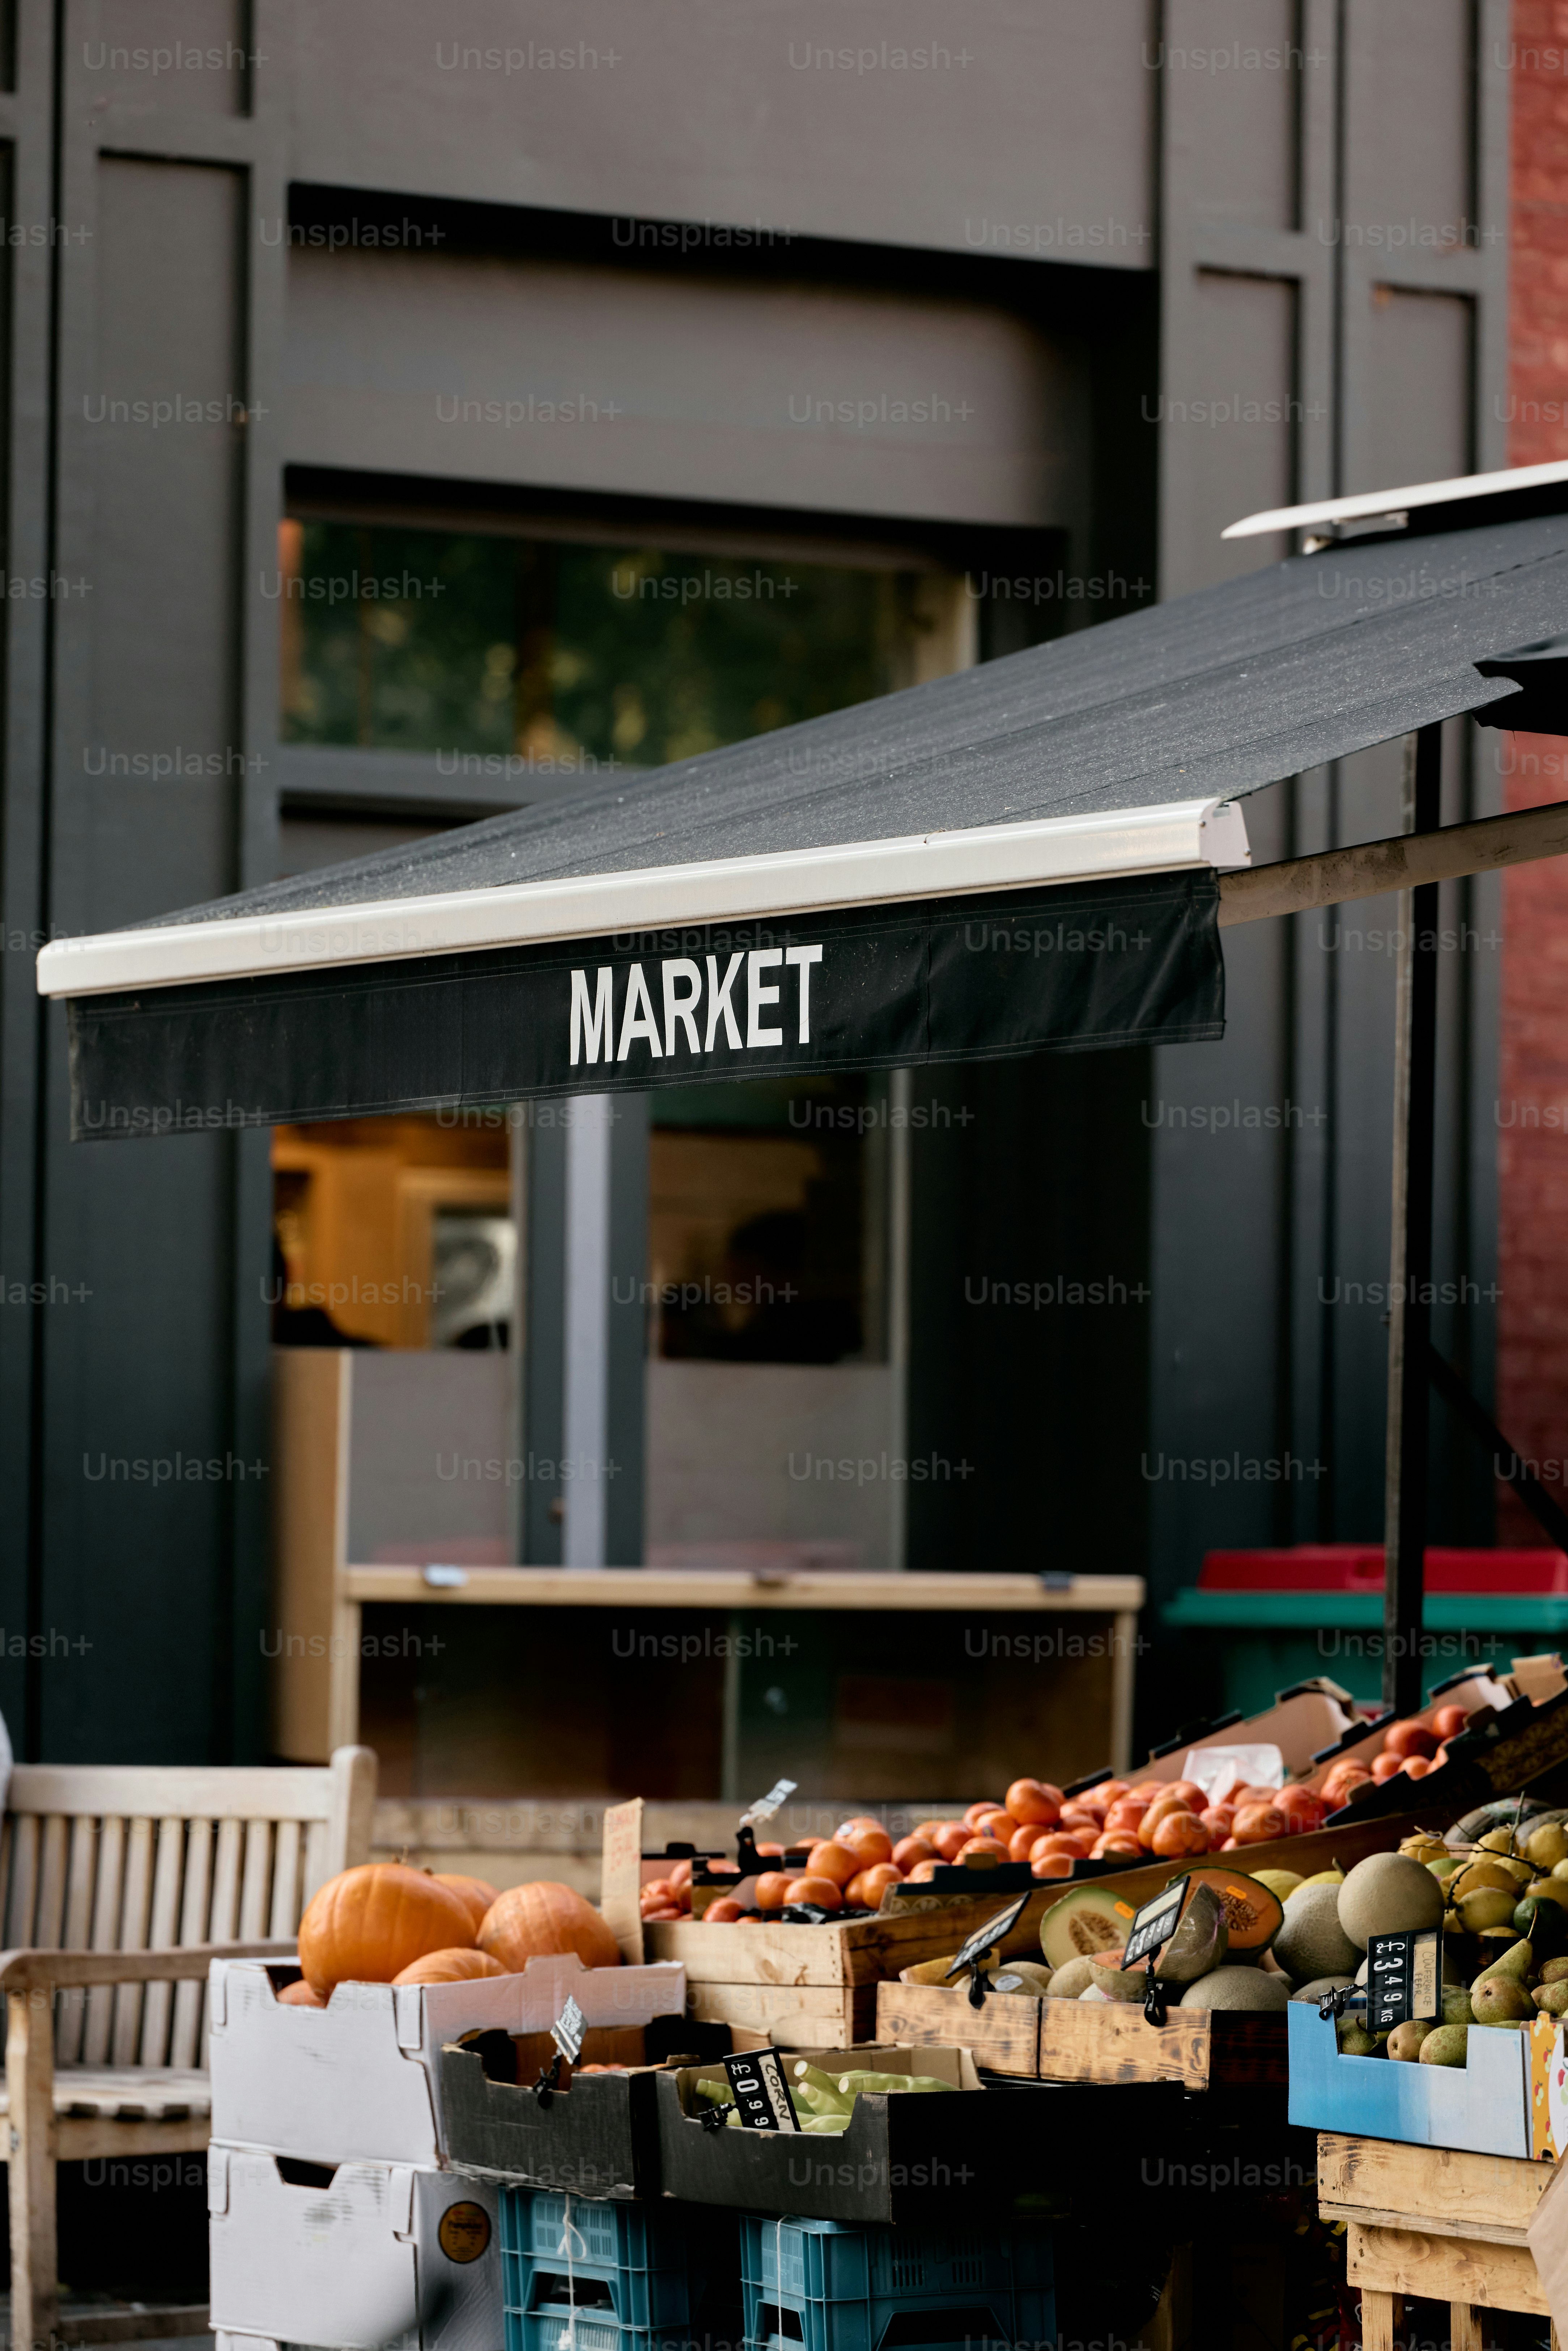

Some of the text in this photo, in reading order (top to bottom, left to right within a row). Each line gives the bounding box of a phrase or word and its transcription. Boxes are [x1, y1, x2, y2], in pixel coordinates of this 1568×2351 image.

[570, 944, 823, 1065] MARKET
[1373, 1941, 1406, 2023] £3.49 KG
[731, 2063, 769, 2126] £0.99
[765, 2064, 791, 2120] CORN
